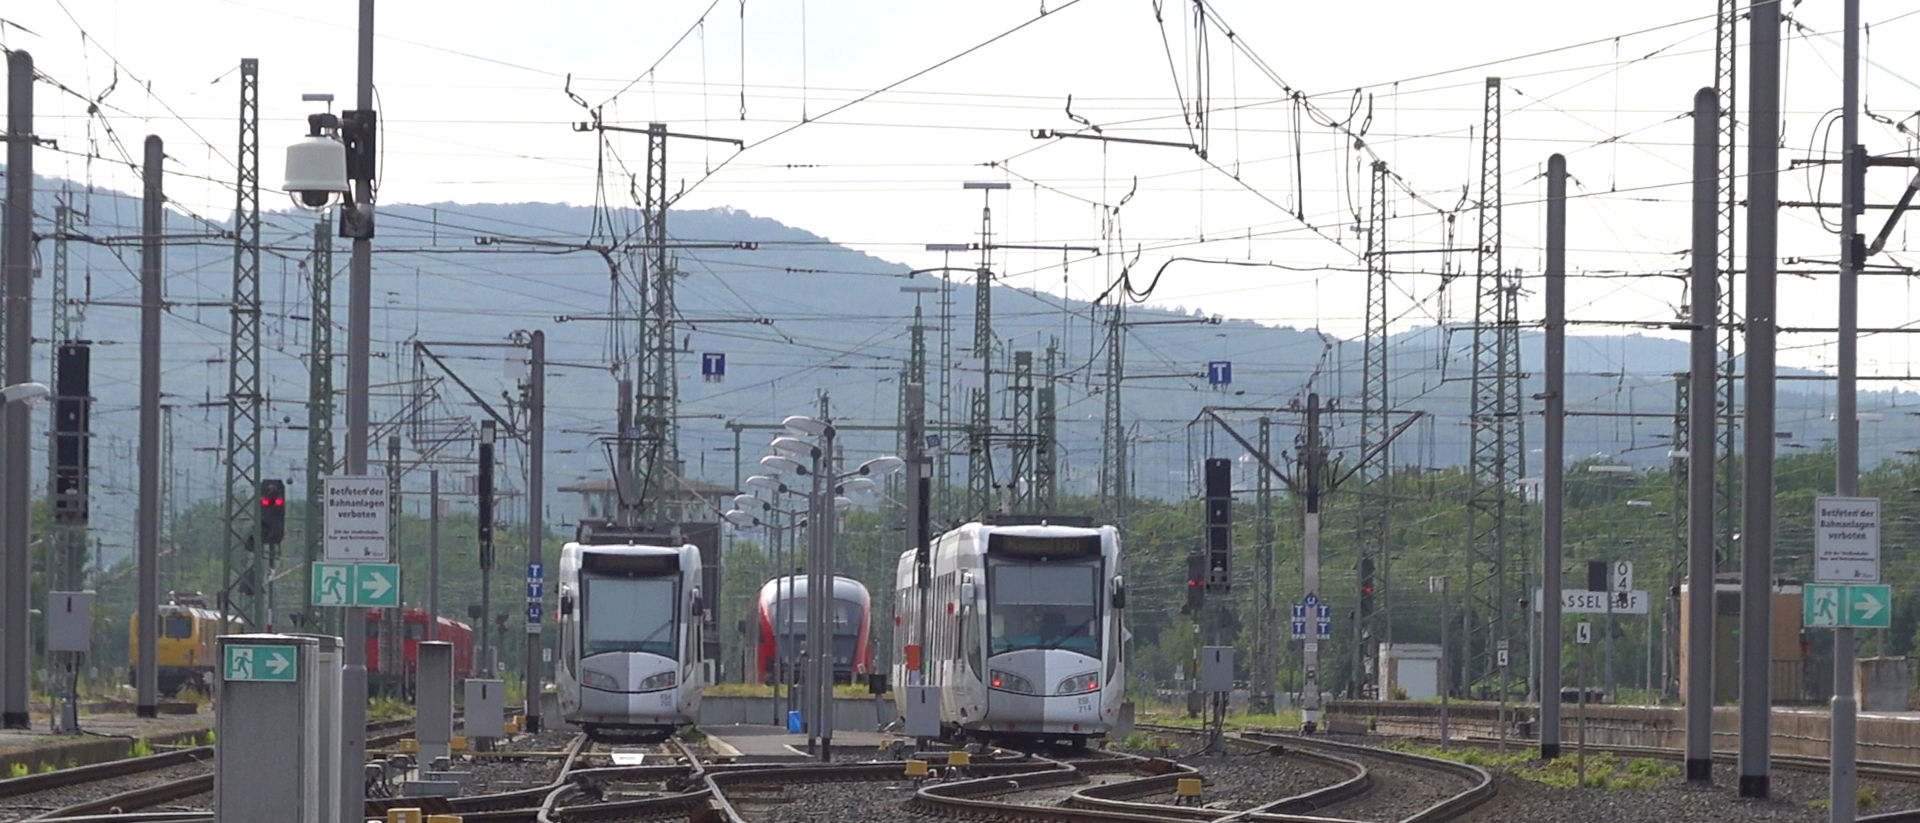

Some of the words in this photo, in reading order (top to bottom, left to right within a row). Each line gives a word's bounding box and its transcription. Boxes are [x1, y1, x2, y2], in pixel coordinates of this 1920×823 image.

[706, 355, 721, 373] T
[1212, 363, 1227, 381] T
[330, 487, 368, 495] Betreten
[369, 487, 383, 495] der
[329, 499, 384, 508] Bahnanlagen
[338, 510, 376, 518] verboten
[1821, 508, 1860, 517] Betreten
[1820, 520, 1874, 530] Bahnanlagen
[1828, 531, 1866, 539] verboten
[530, 564, 540, 576] T
[530, 584, 540, 596] T
[1295, 605, 1303, 616] T
[1319, 605, 1328, 617] T
[1295, 622, 1303, 633] T
[1318, 623, 1328, 634] T
